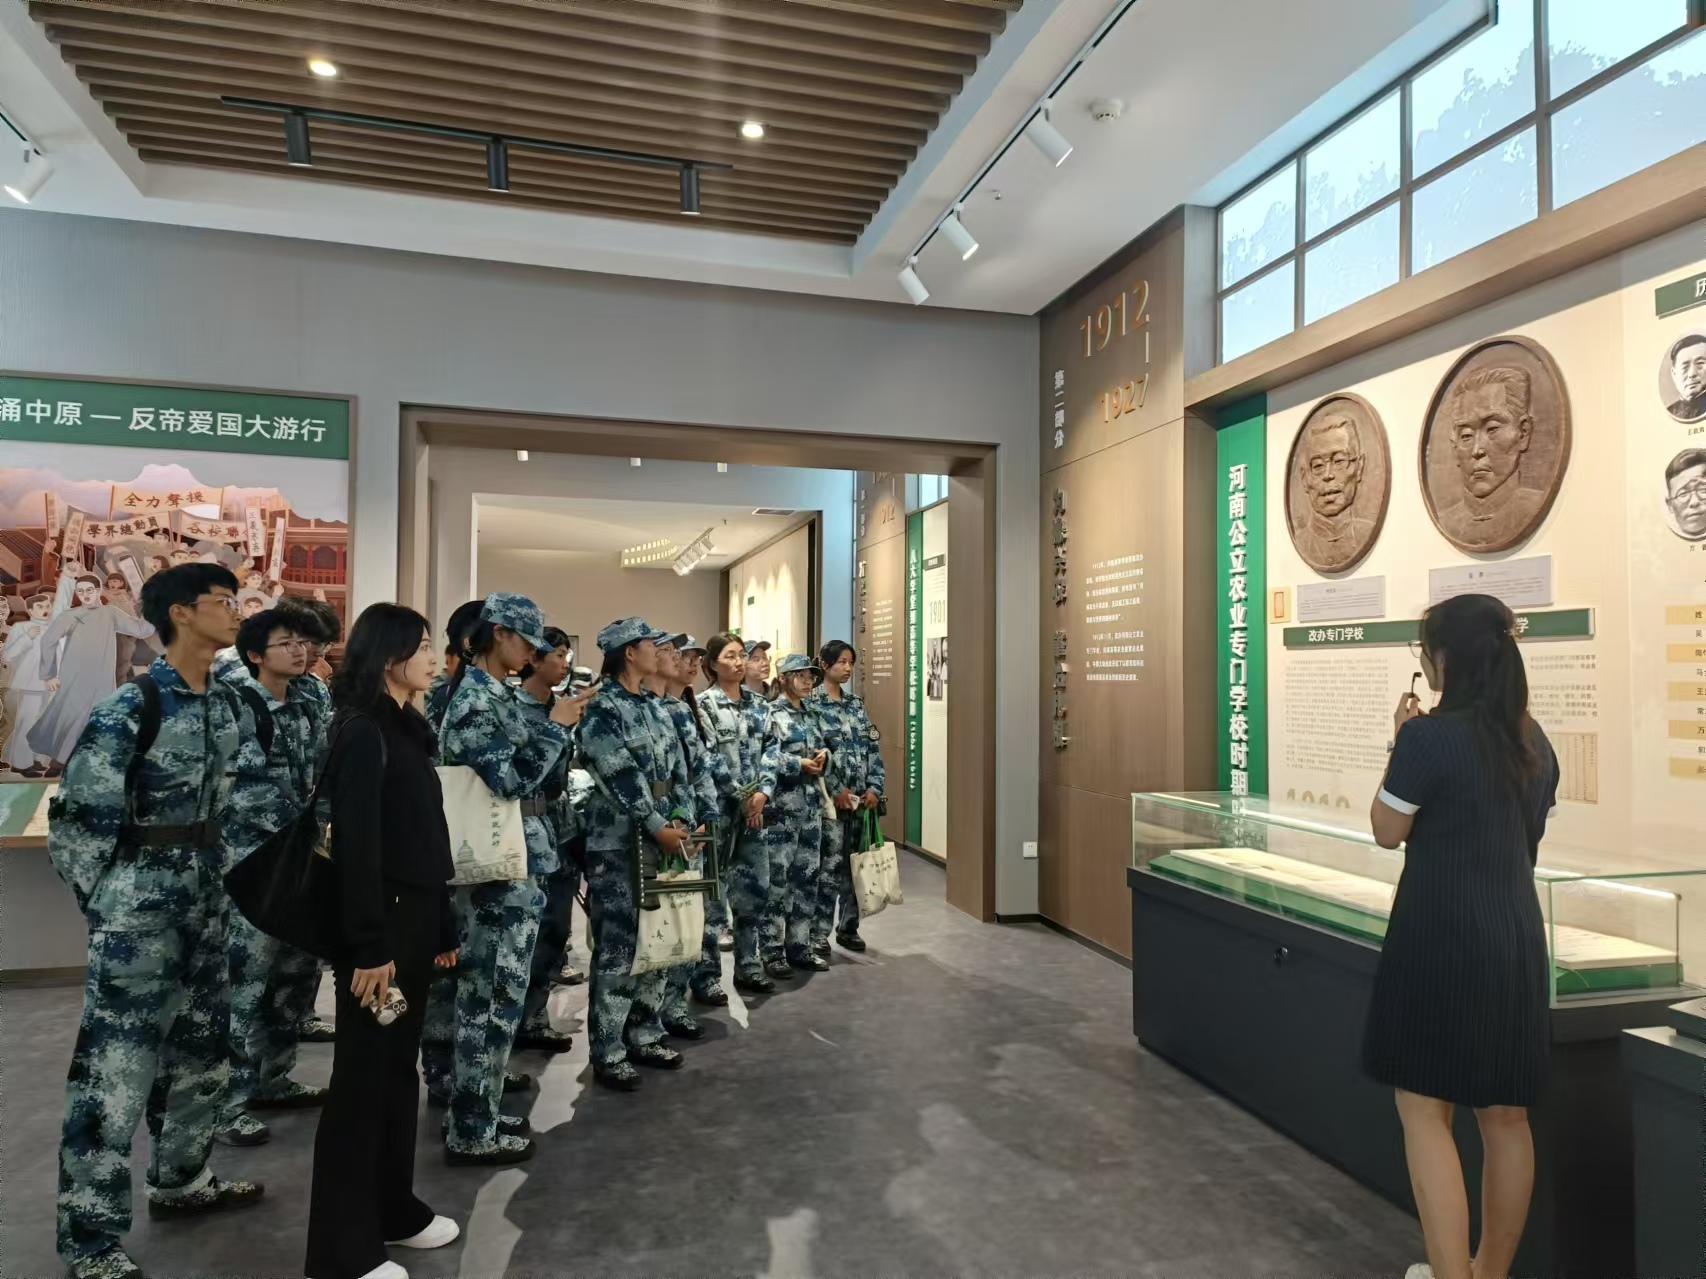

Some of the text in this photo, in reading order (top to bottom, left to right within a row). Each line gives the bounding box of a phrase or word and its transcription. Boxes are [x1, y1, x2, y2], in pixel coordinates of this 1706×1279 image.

[1080, 280, 1149, 358] 1912
[1101, 373, 1149, 424] 1927
[1228, 464, 1249, 796] 河南公立农业专门学校时期
[1308, 626, 1364, 642] 改办专门学校
